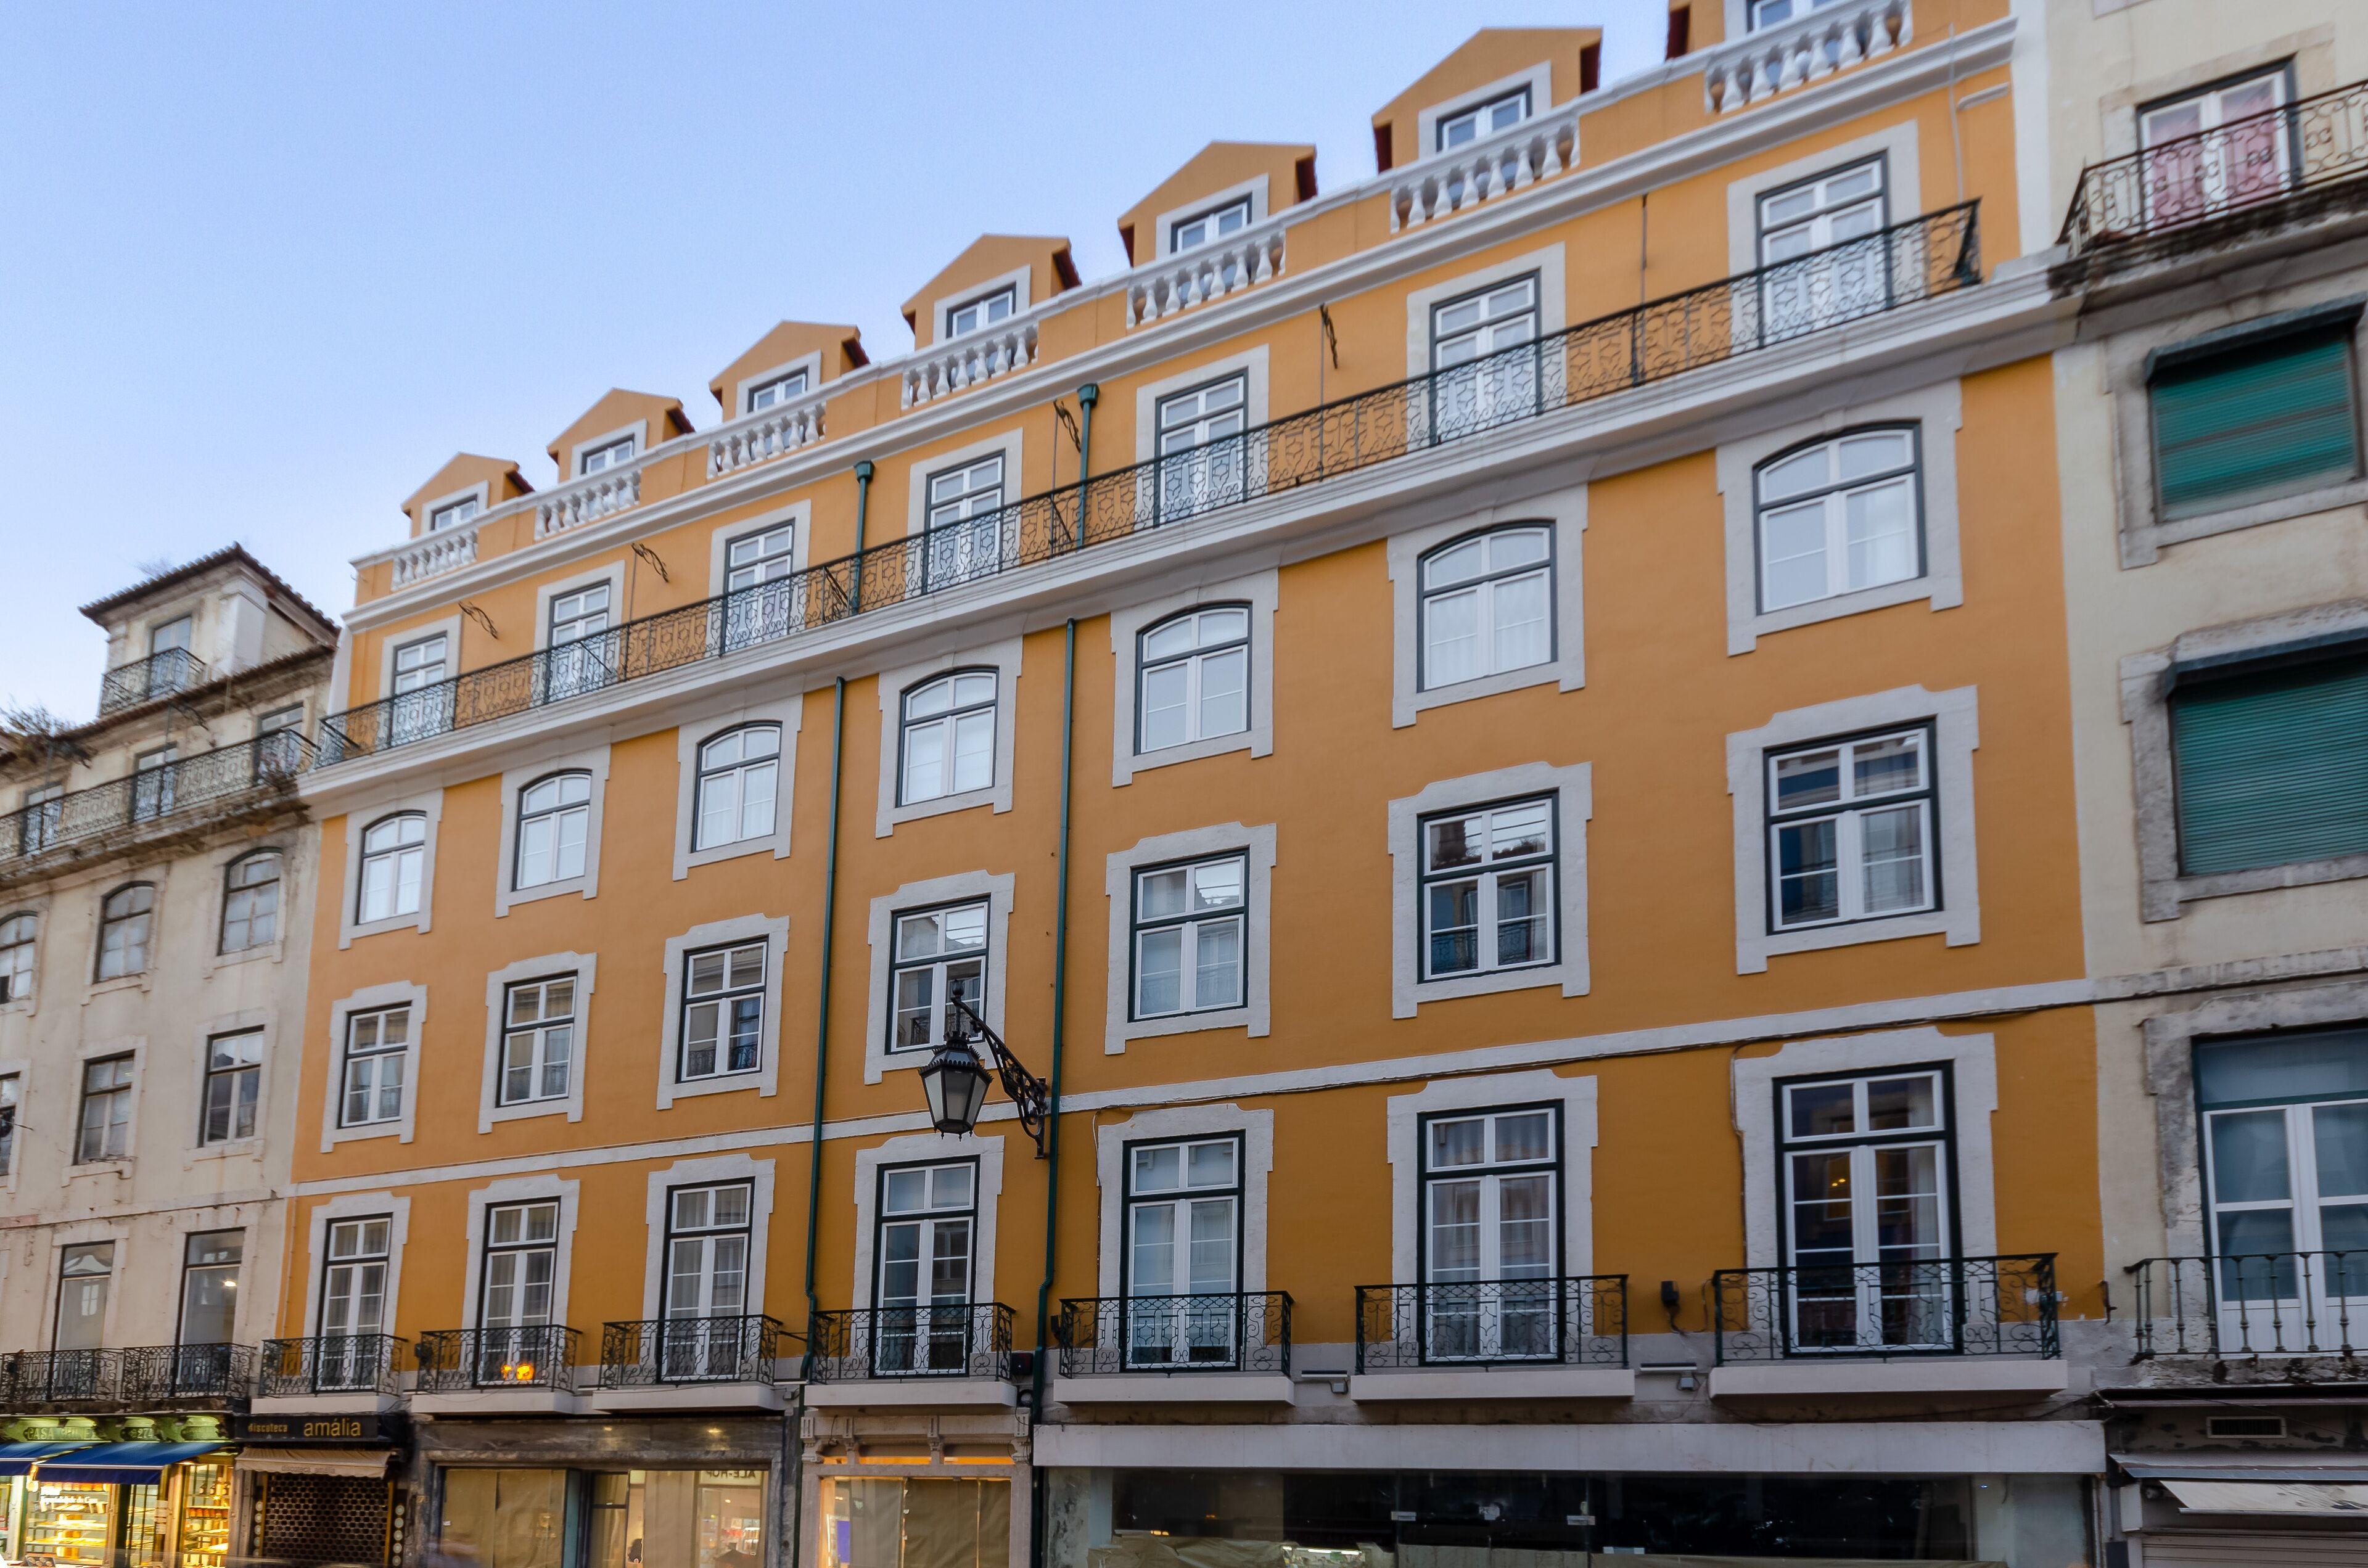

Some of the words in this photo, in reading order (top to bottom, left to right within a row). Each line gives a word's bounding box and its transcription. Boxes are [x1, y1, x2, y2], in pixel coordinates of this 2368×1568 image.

[28, 1427, 54, 1440] CASA
[249, 1423, 288, 1432] discoteca
[303, 1418, 361, 1437] amália
